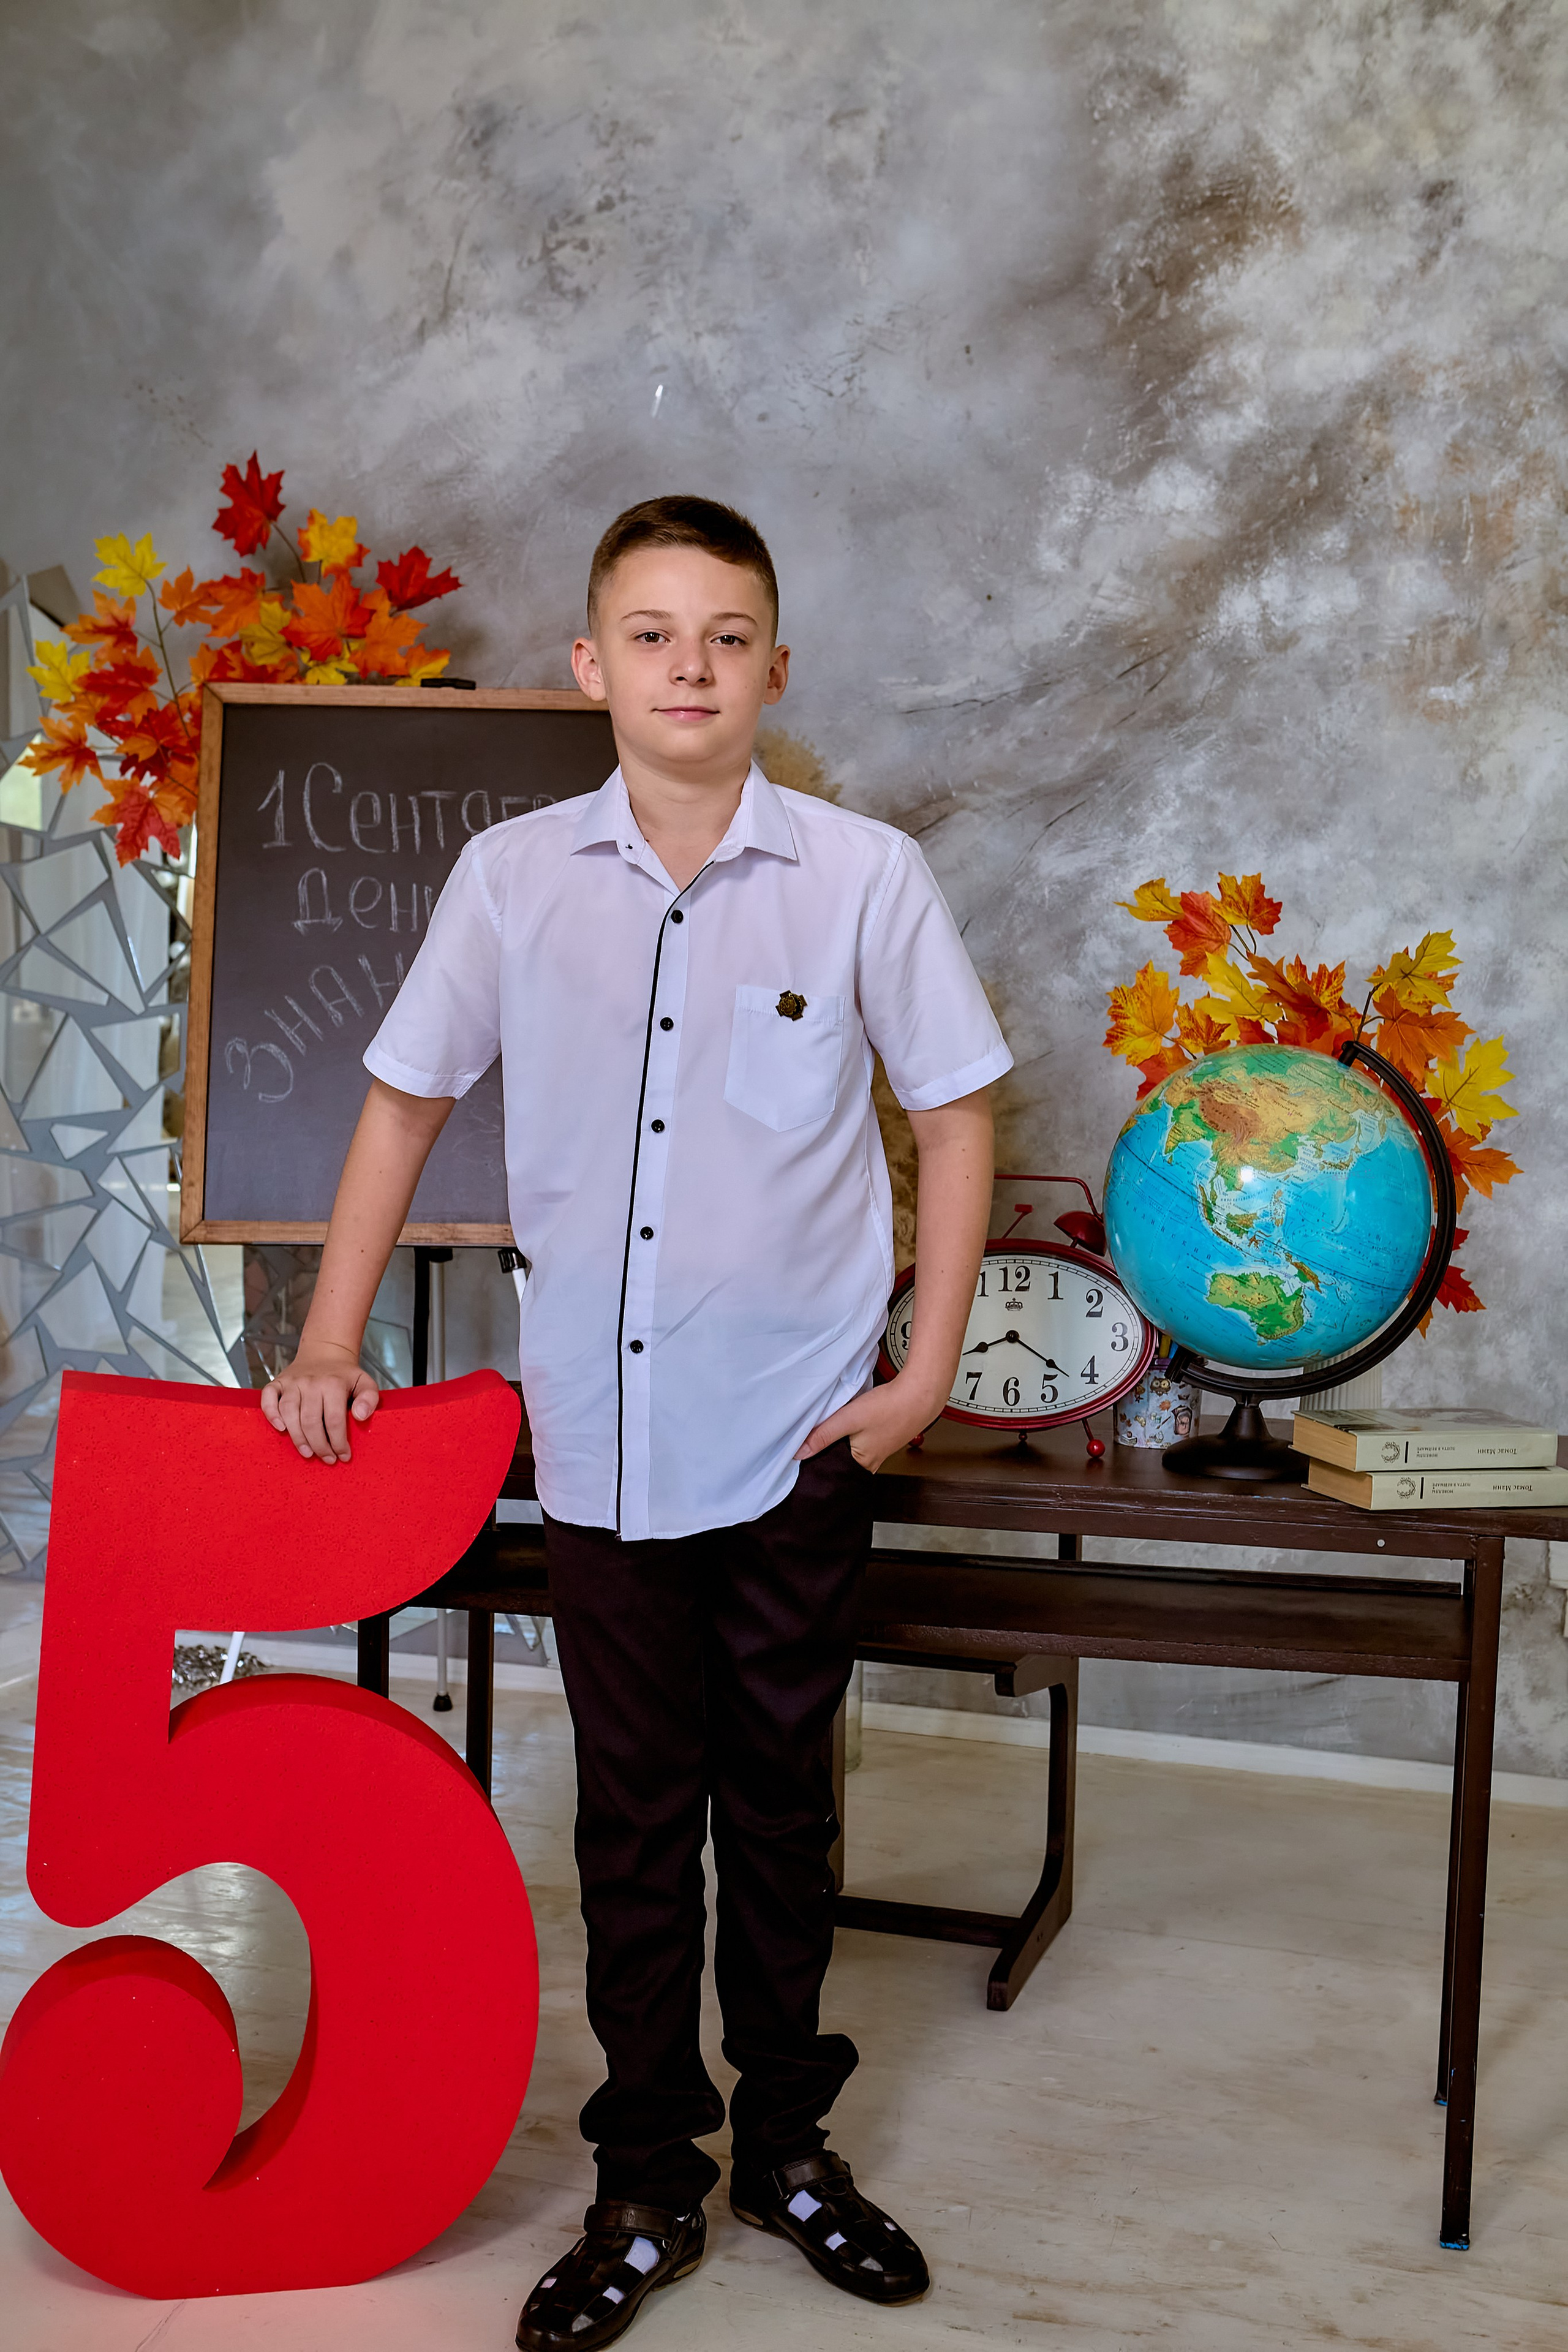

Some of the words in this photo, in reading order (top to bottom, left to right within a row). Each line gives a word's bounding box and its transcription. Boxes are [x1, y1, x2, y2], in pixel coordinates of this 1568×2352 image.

[303, 762, 559, 854] Сентя
[998, 1265, 1031, 1292] 12
[1047, 1272, 1064, 1300] 1
[1085, 1289, 1104, 1317] 2
[1110, 1322, 1129, 1352] 3
[1080, 1355, 1099, 1385] 4
[965, 1371, 982, 1401] 7
[1003, 1377, 1020, 1406] 6
[1041, 1373, 1058, 1403] 5
[0, 1369, 540, 2301] 5
